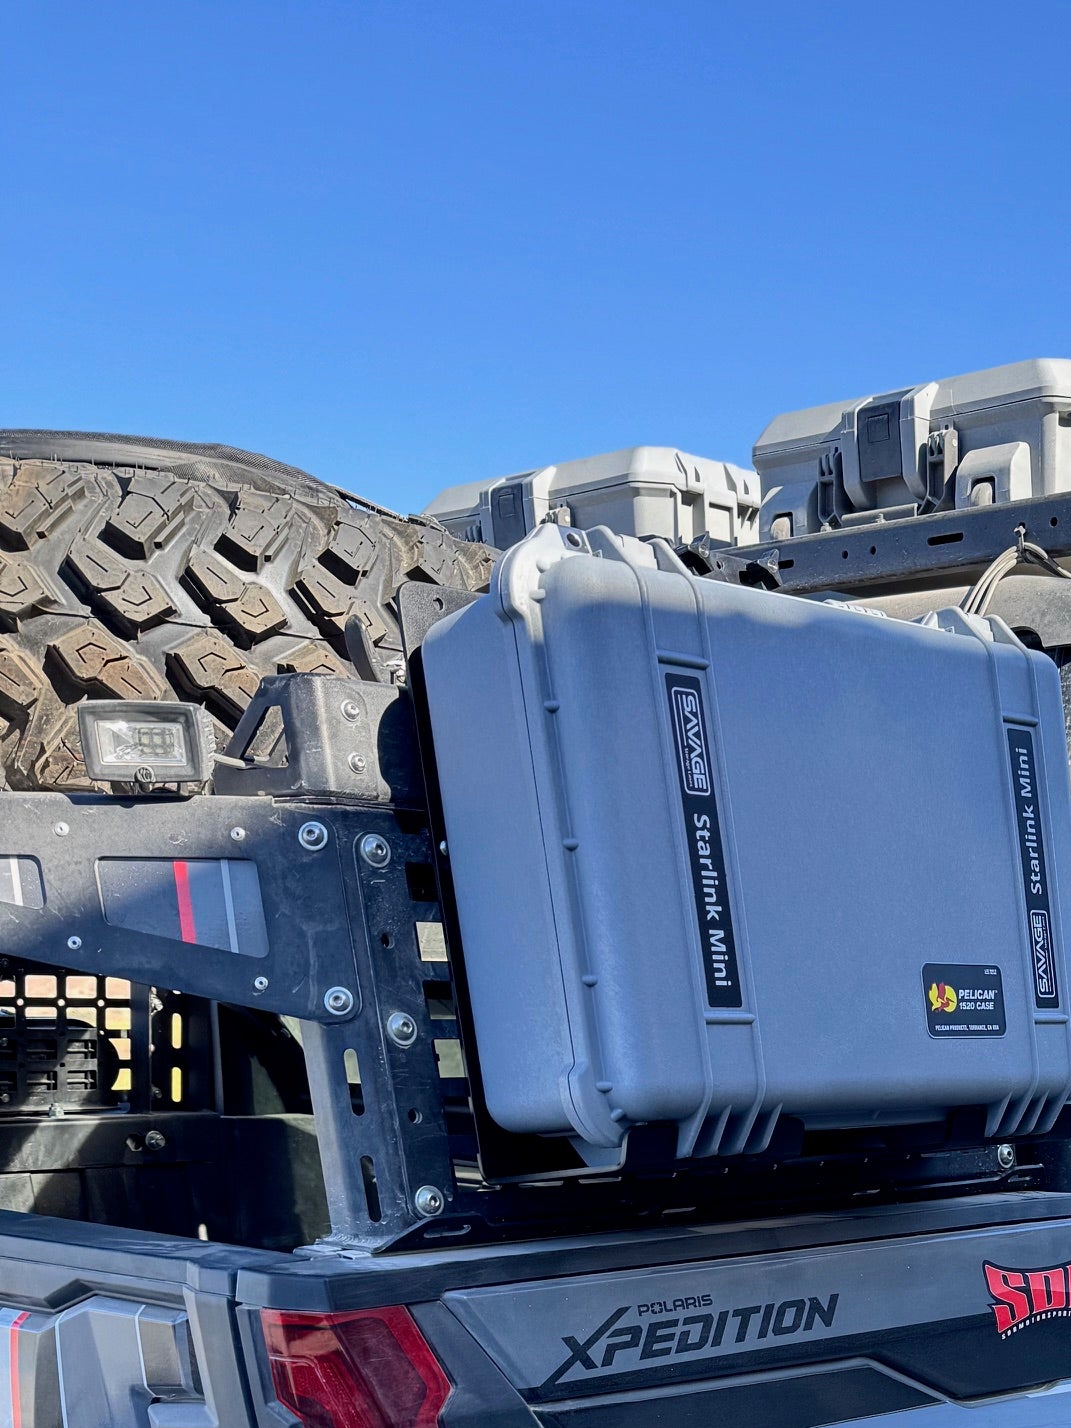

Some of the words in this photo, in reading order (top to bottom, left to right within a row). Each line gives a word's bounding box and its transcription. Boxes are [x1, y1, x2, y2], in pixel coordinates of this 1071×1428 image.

[682, 694, 707, 790] SAVAGE
[1015, 747, 1032, 798] Mini
[1022, 804, 1042, 895] Starlink
[693, 813, 722, 921] Starlink
[708, 929, 732, 986] Mini
[1033, 915, 1049, 992] SAVAGE
[959, 1001, 975, 1010] 1520
[976, 1001, 994, 1010] CASE
[548, 1293, 840, 1380] XPEDITION
[637, 1293, 713, 1317] POLARIS
